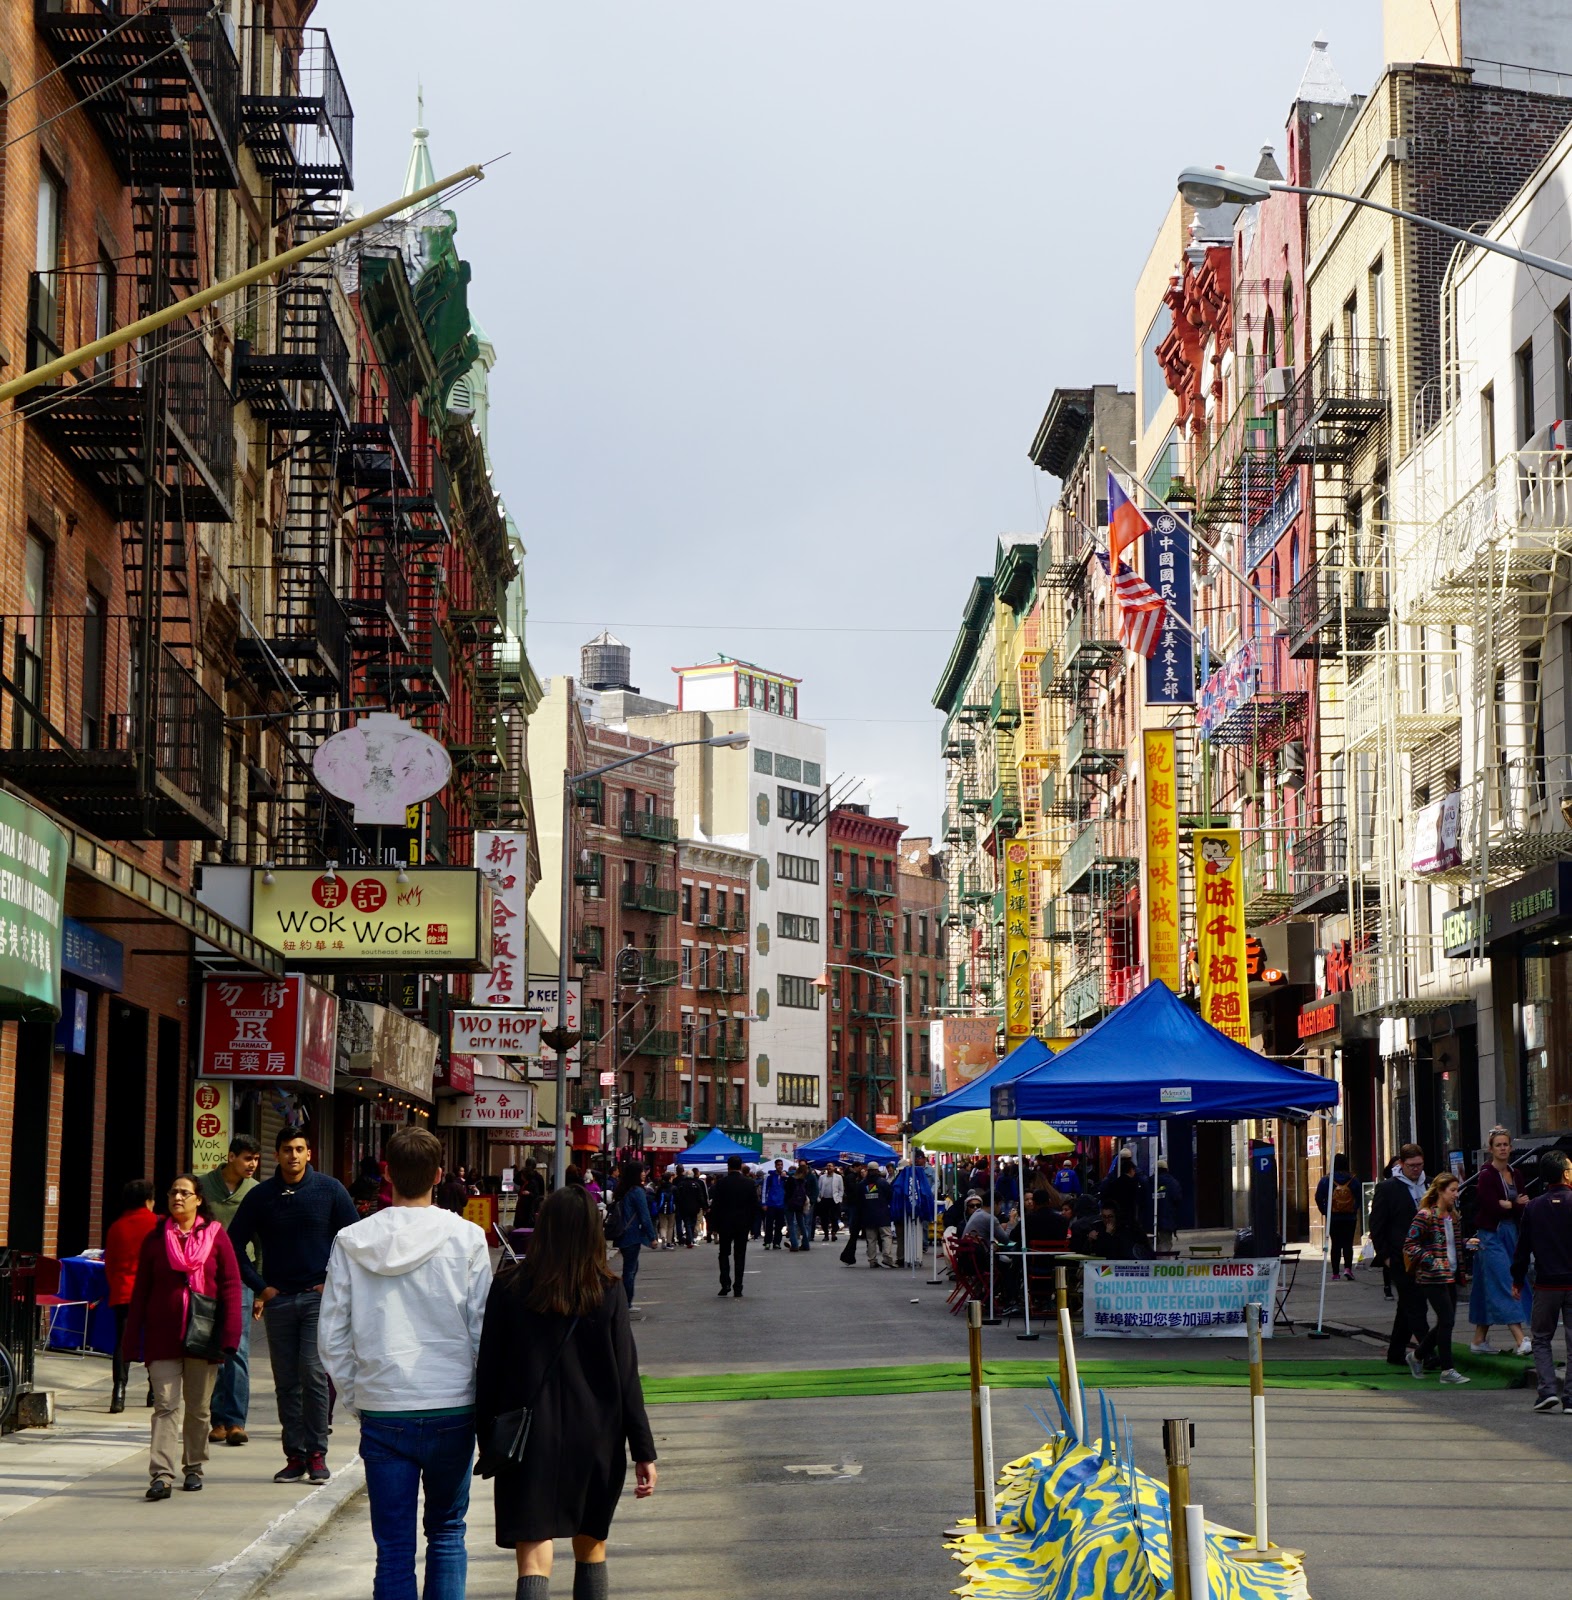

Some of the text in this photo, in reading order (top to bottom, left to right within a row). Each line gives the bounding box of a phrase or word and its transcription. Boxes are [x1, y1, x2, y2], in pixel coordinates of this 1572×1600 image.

[1159, 536, 1179, 700] 中國國民駐美東支部
[277, 910, 347, 934] Wok
[353, 921, 422, 944] Wok
[1156, 931, 1171, 941] ELITE
[1443, 911, 1467, 950] HERS
[1204, 878, 1242, 1024] 味千拉麵
[1265, 971, 1277, 979] 16
[493, 995, 505, 1004] 15
[537, 990, 558, 1002] KEE
[458, 1016, 538, 1035] WO HOP
[946, 1020, 996, 1029] PEKING
[952, 1028, 988, 1036] DUCK
[231, 1041, 270, 1050] PHARMACY
[469, 1037, 524, 1049] CITY INC.
[948, 1036, 992, 1044] HOUSE
[213, 1052, 286, 1073] 西藥房
[460, 1108, 525, 1119] 17 WO HOP
[488, 1130, 503, 1139] HOP
[505, 1130, 520, 1139] KEE
[192, 1139, 220, 1149] Wok
[201, 1152, 228, 1162] Wok
[1260, 1159, 1269, 1171] P
[1153, 1265, 1184, 1277] FOOD
[1186, 1264, 1210, 1276] FUN
[1212, 1264, 1254, 1276] GAMES
[1094, 1279, 1270, 1295] CHINATOWN WELCOMES YOU
[1094, 1296, 1112, 1311] TO
[1115, 1296, 1143, 1310] OUR
[1146, 1295, 1215, 1310] WEEKEND
